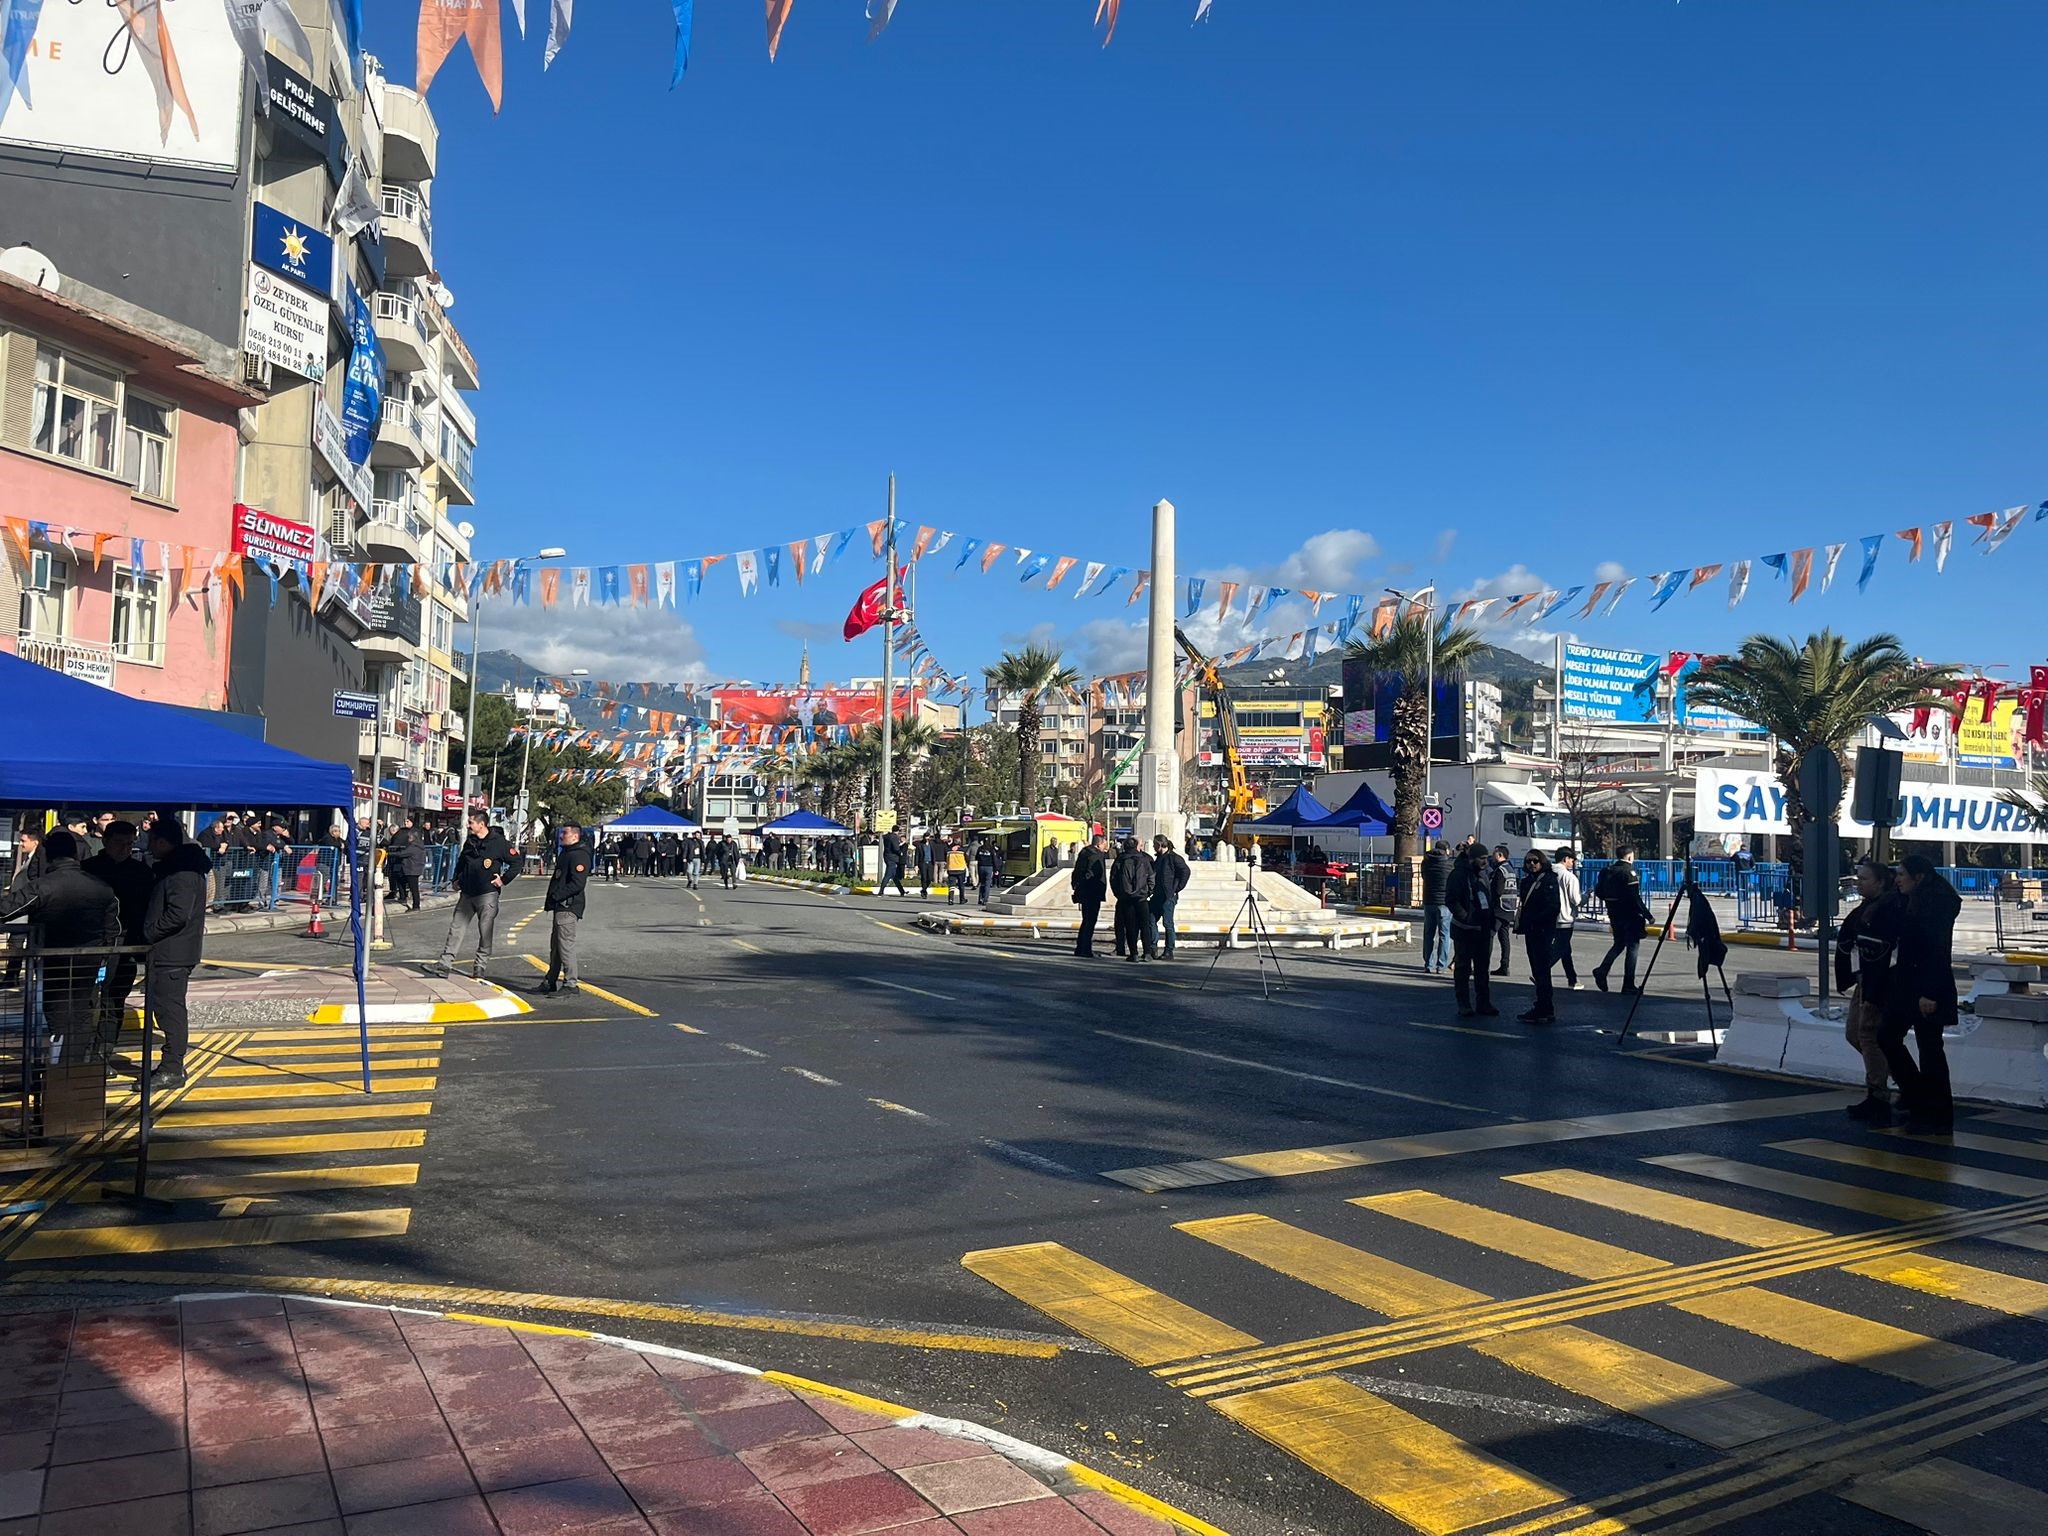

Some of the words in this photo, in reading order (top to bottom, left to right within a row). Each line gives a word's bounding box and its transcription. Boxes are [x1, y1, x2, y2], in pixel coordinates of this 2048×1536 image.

[285, 78, 315, 108] PROJE
[270, 88, 325, 135] GELİŞTİRME
[282, 263, 290, 272] AK
[290, 268, 306, 279] PARTİ
[272, 286, 308, 312] ZEYBEK
[253, 292, 277, 314] ÖZEL
[280, 306, 325, 336] GÜVENLİK
[274, 320, 304, 343] KURSU
[248, 328, 266, 342] 0256
[268, 336, 281, 350] 213
[283, 343, 292, 354] 00
[294, 348, 302, 359] 11
[248, 340, 266, 355] 0506
[268, 349, 280, 362] 484
[283, 355, 291, 366] 91
[293, 360, 302, 370] 28
[276, 544, 314, 562] KURSLARI
[1567, 645, 1590, 657] TREND
[1591, 649, 1618, 659] OLMAK
[1618, 652, 1644, 665] KOLAY,
[1566, 660, 1591, 672] MESELE
[1592, 662, 1614, 676] TARİH
[1565, 673, 1582, 686] LİDER
[1583, 678, 1608, 690] OLMAK
[337, 700, 376, 712] CUMHURİYET
[1564, 689, 1588, 701] MESELE
[1589, 691, 1621, 705] YÜZYILIN
[1565, 702, 1586, 716] LİDERİ
[1587, 708, 1616, 719] OLMAK!
[1718, 784, 1788, 821] SAY
[1851, 795, 2036, 832] UMHURB
